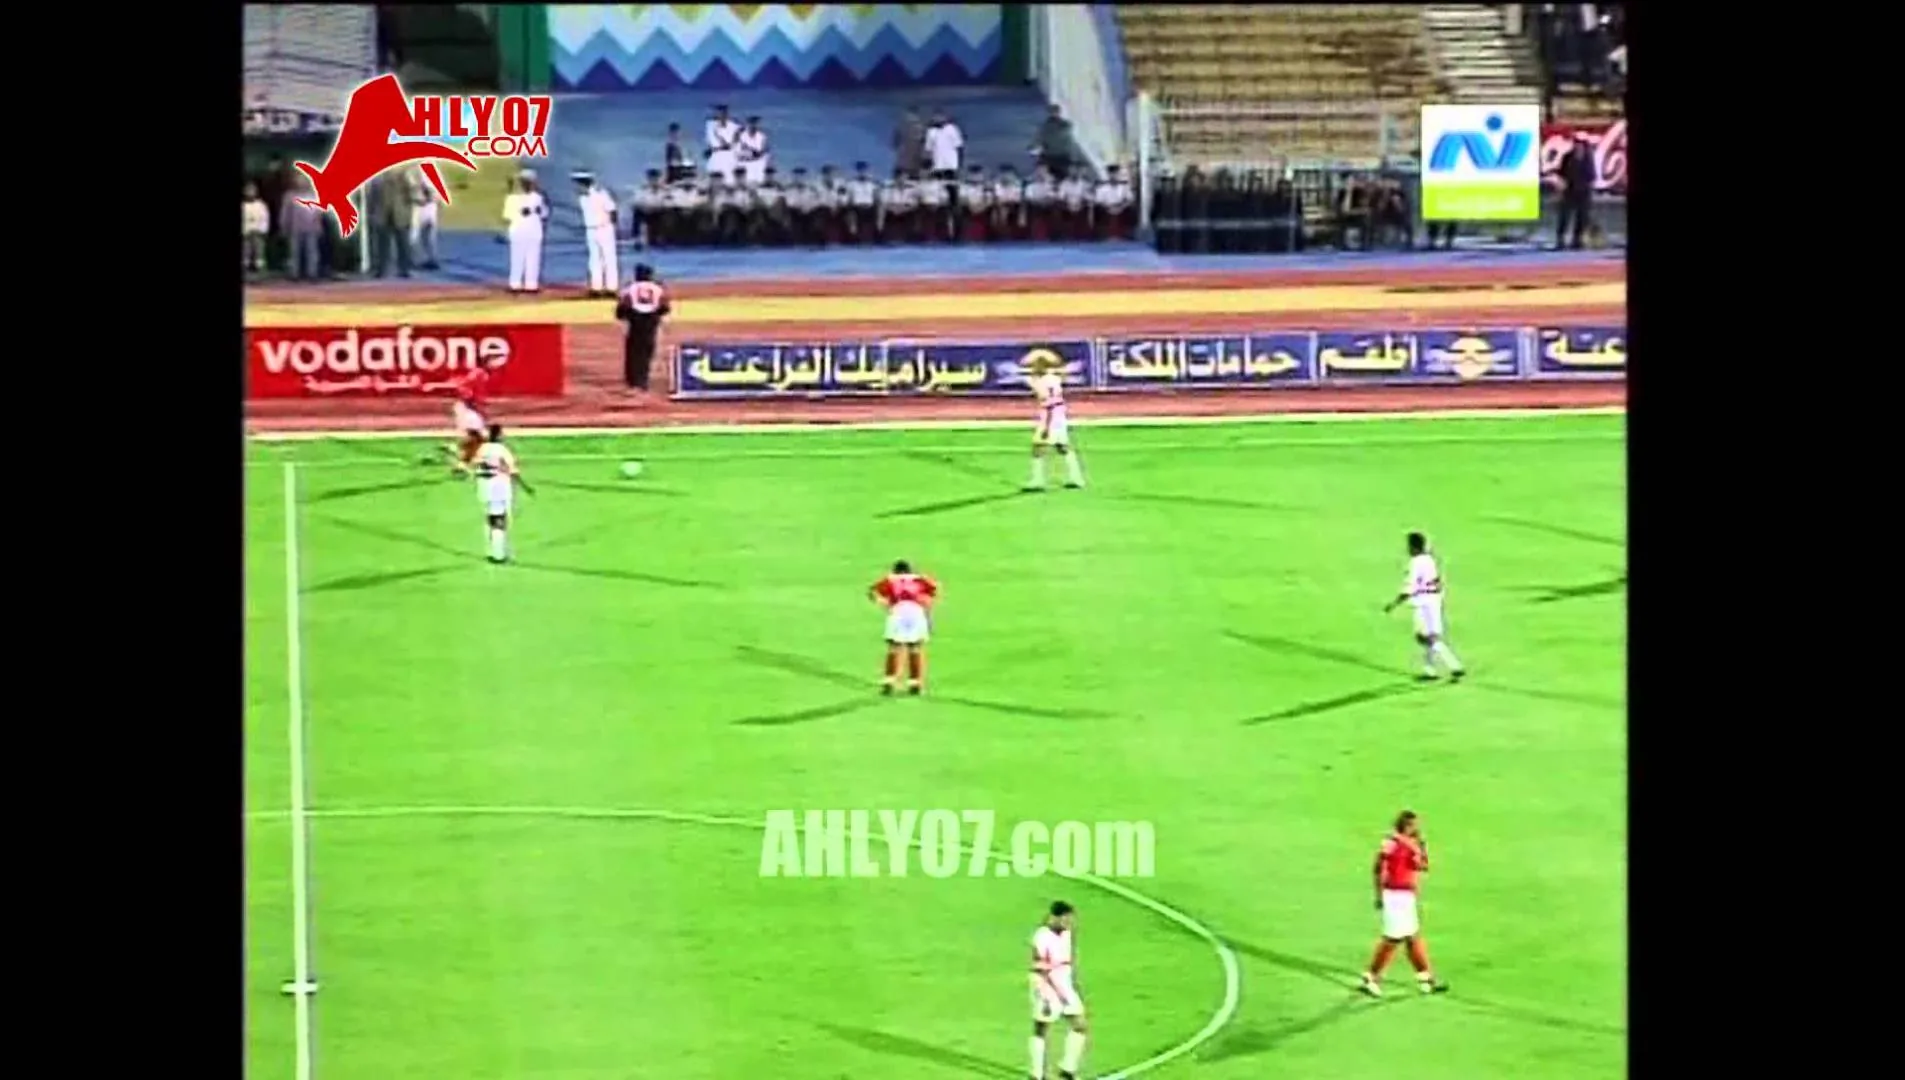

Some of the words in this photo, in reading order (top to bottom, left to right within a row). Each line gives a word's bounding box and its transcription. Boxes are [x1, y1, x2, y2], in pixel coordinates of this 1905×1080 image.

[258, 327, 511, 373] vodafone
[683, 344, 831, 390] الفراعنة
[834, 346, 987, 392] سيراميك
[1108, 339, 1187, 379] الملكة
[1188, 335, 1302, 377] حمامات
